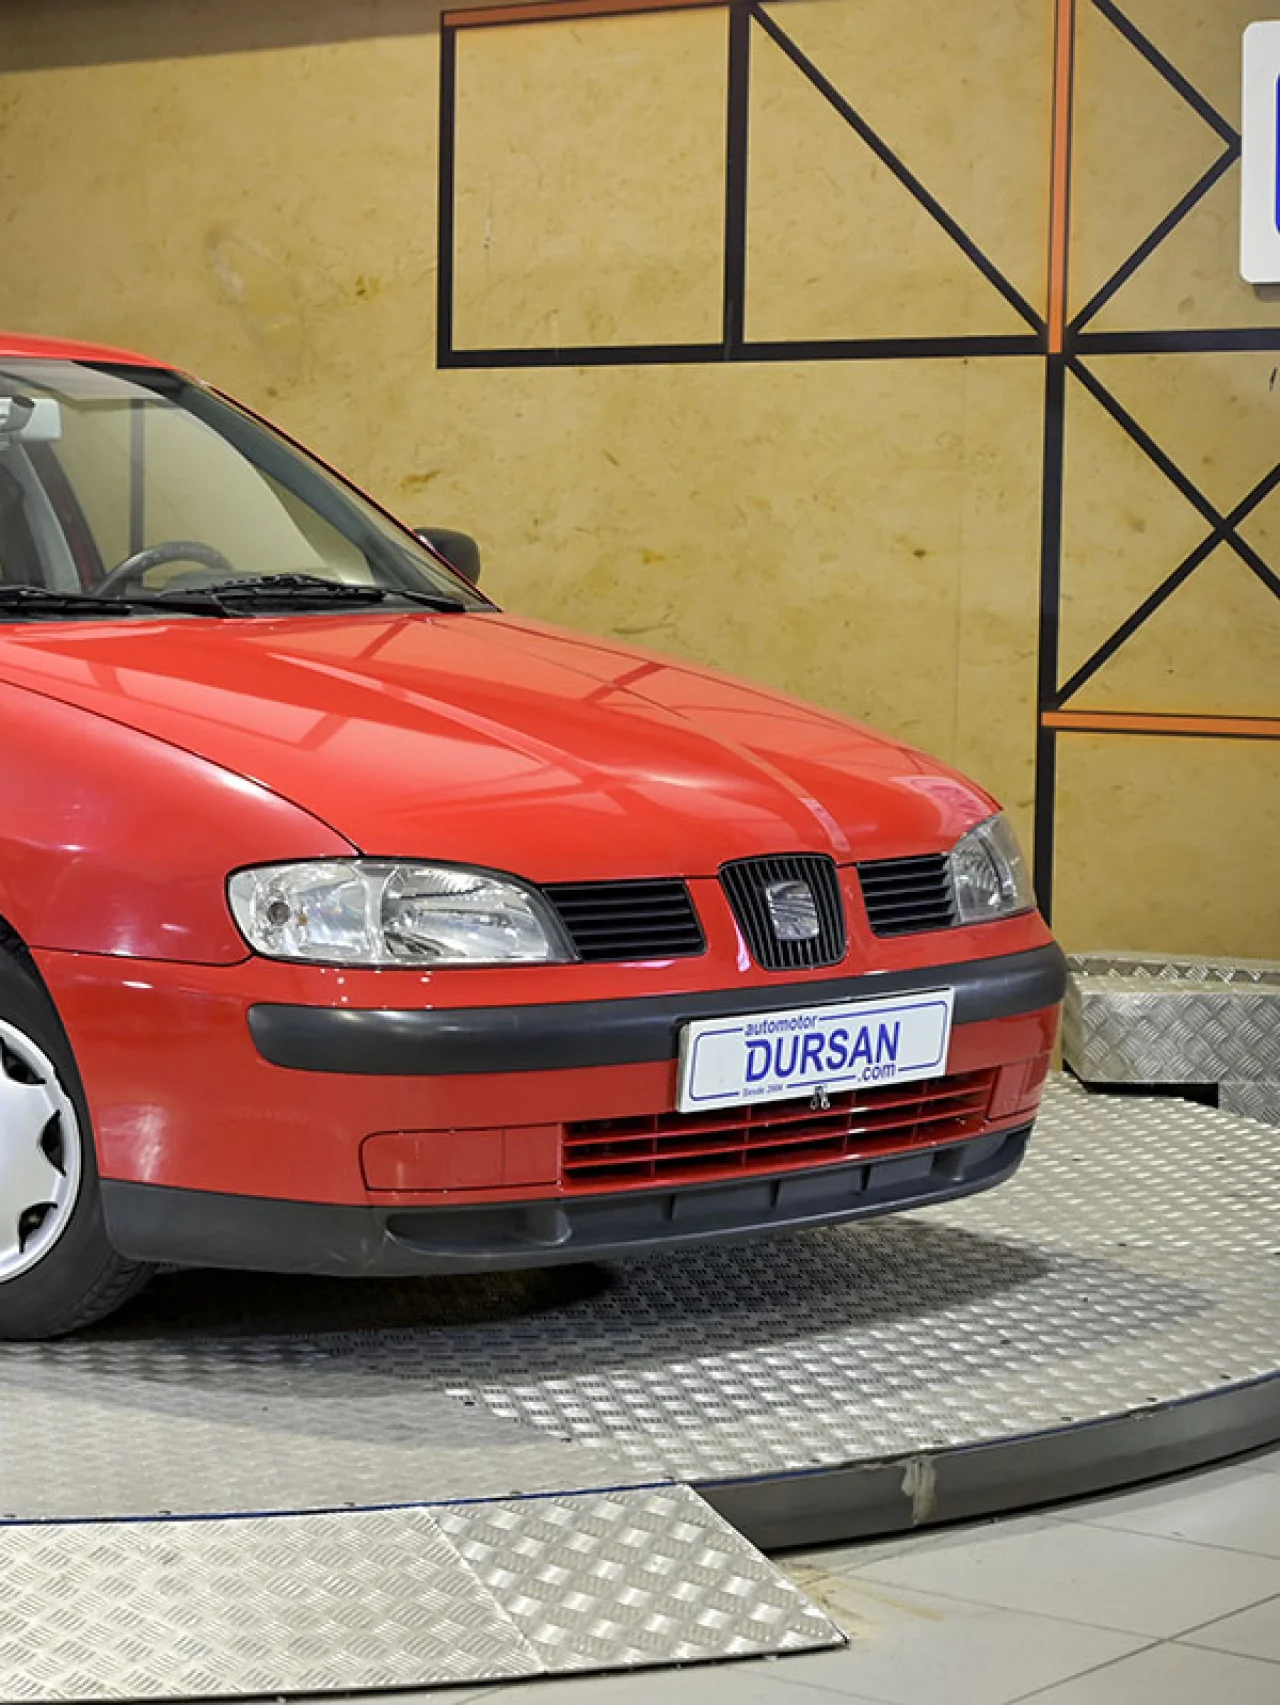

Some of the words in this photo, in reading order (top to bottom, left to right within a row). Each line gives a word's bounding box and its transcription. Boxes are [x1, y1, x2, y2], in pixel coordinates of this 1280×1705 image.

[744, 1015, 818, 1036] automotor
[745, 1021, 901, 1082] DURSAN
[857, 1064, 896, 1083] .com
